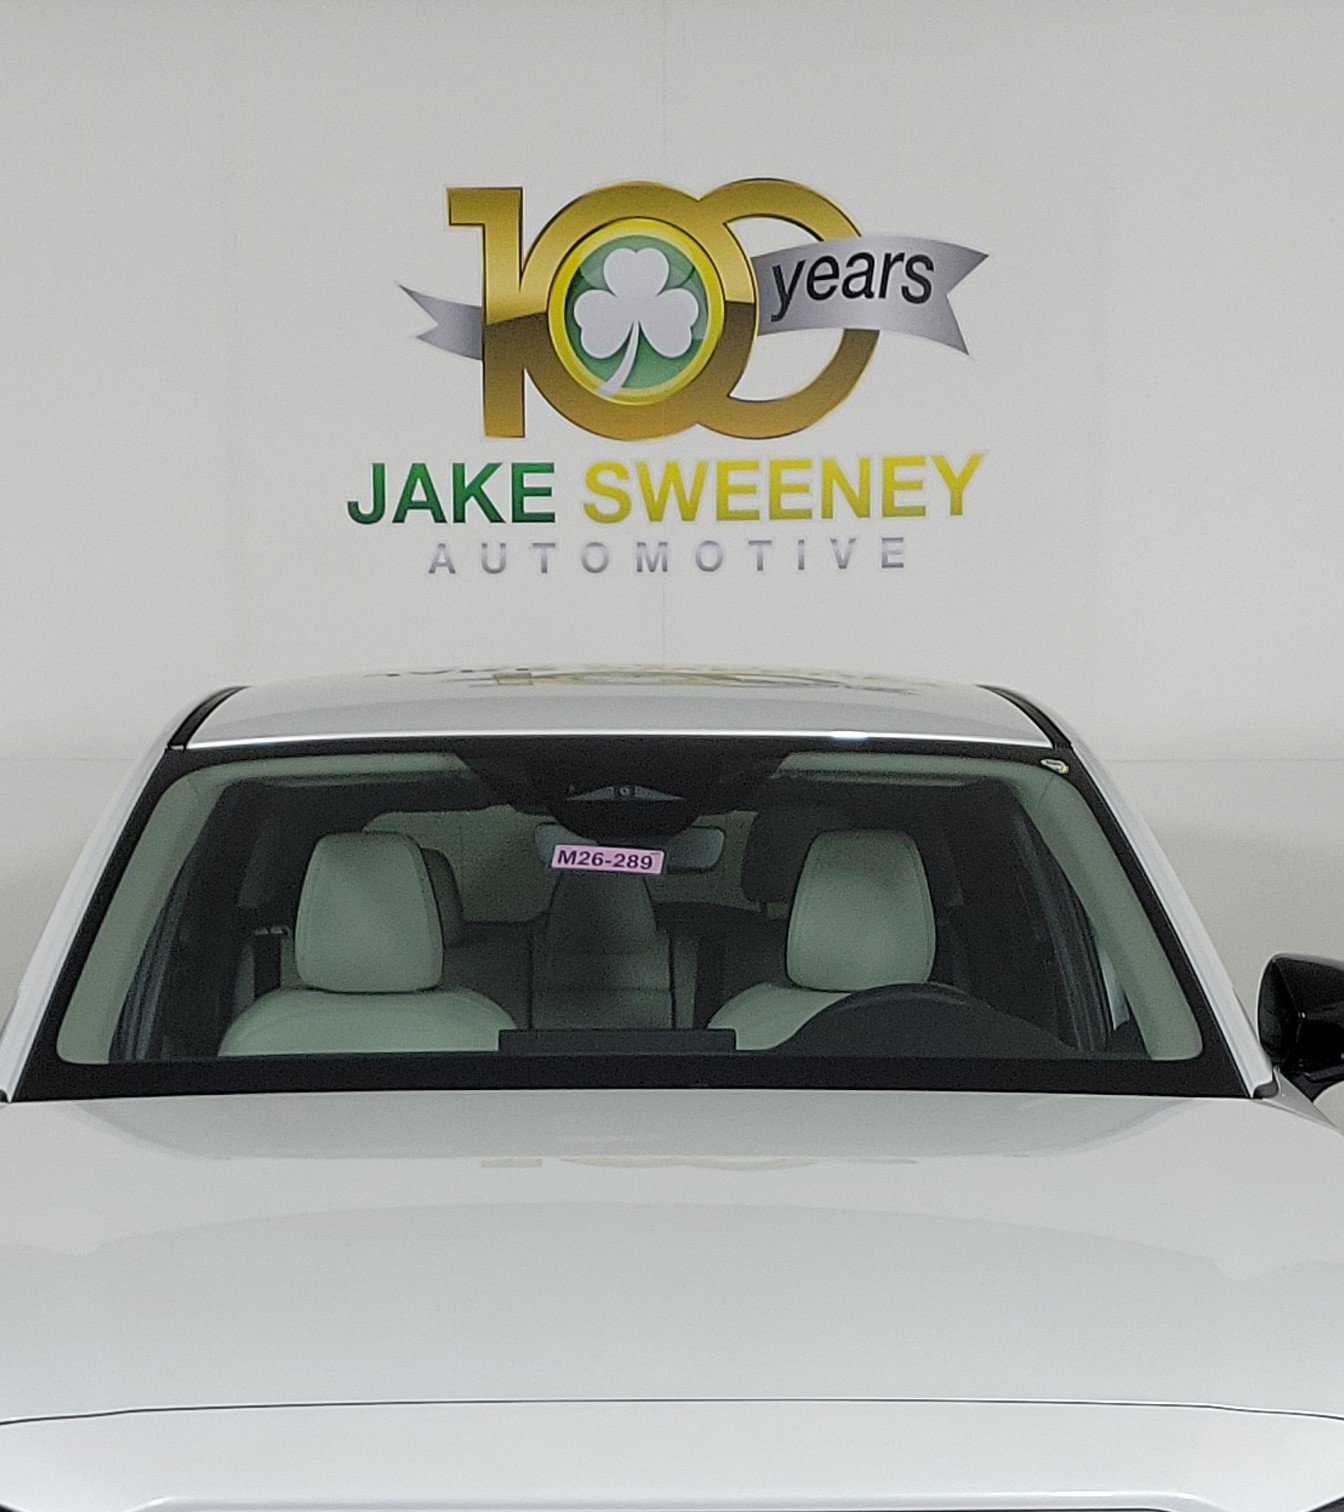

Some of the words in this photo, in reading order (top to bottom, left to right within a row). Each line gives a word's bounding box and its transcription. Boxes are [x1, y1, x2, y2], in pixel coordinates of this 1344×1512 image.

[446, 178, 882, 440] 100
[769, 250, 935, 323] years
[346, 462, 556, 525] JAKE
[582, 452, 986, 524] SWEENEY
[427, 536, 906, 576] AUTOMOTIVE
[557, 849, 654, 870] M26-289
